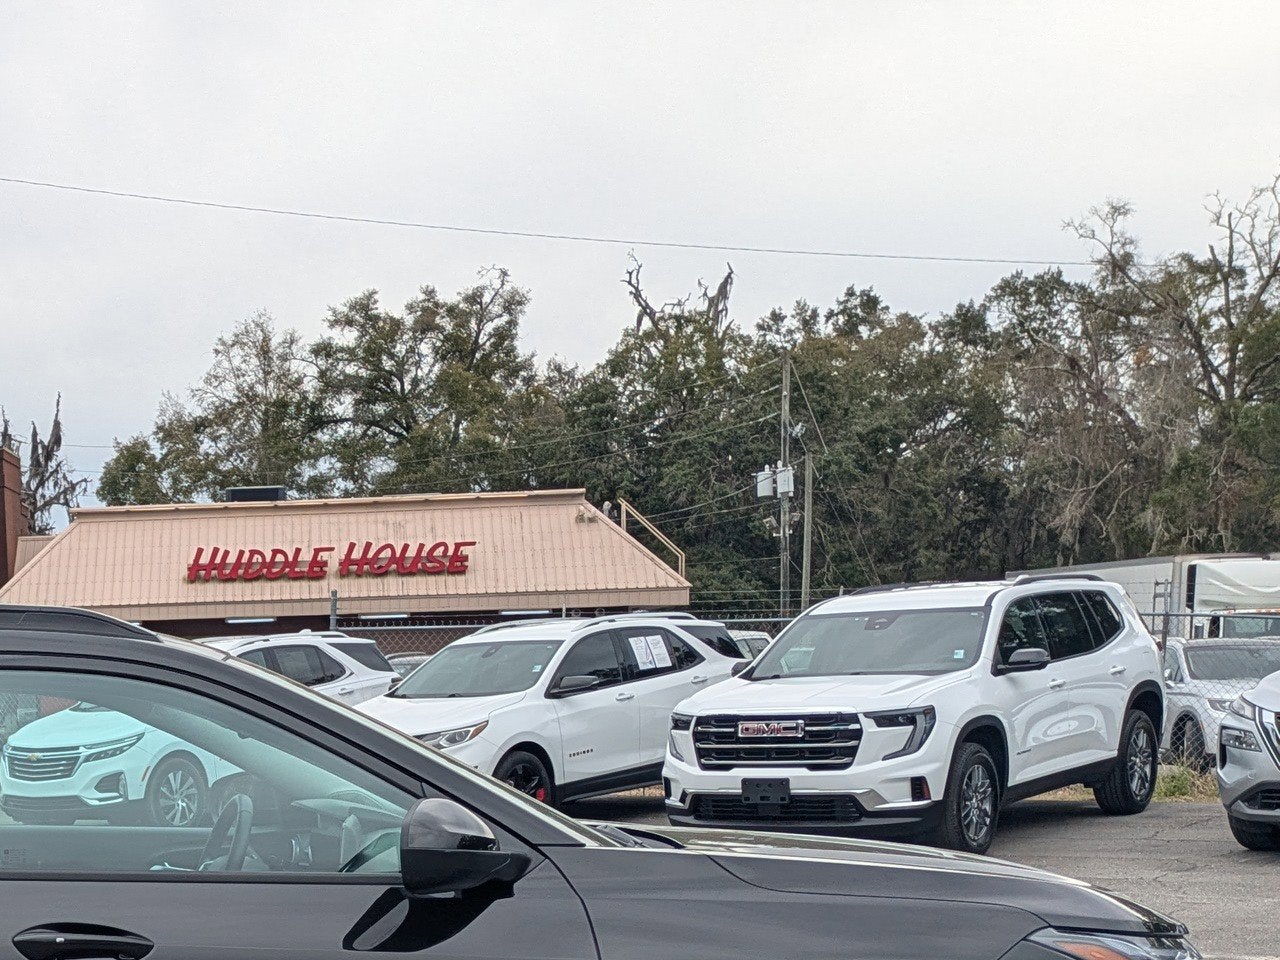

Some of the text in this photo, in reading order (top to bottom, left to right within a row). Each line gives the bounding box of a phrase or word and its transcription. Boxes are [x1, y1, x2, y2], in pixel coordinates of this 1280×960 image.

[187, 541, 477, 582] HUDDLE HOUSE
[740, 722, 799, 737] GMC
